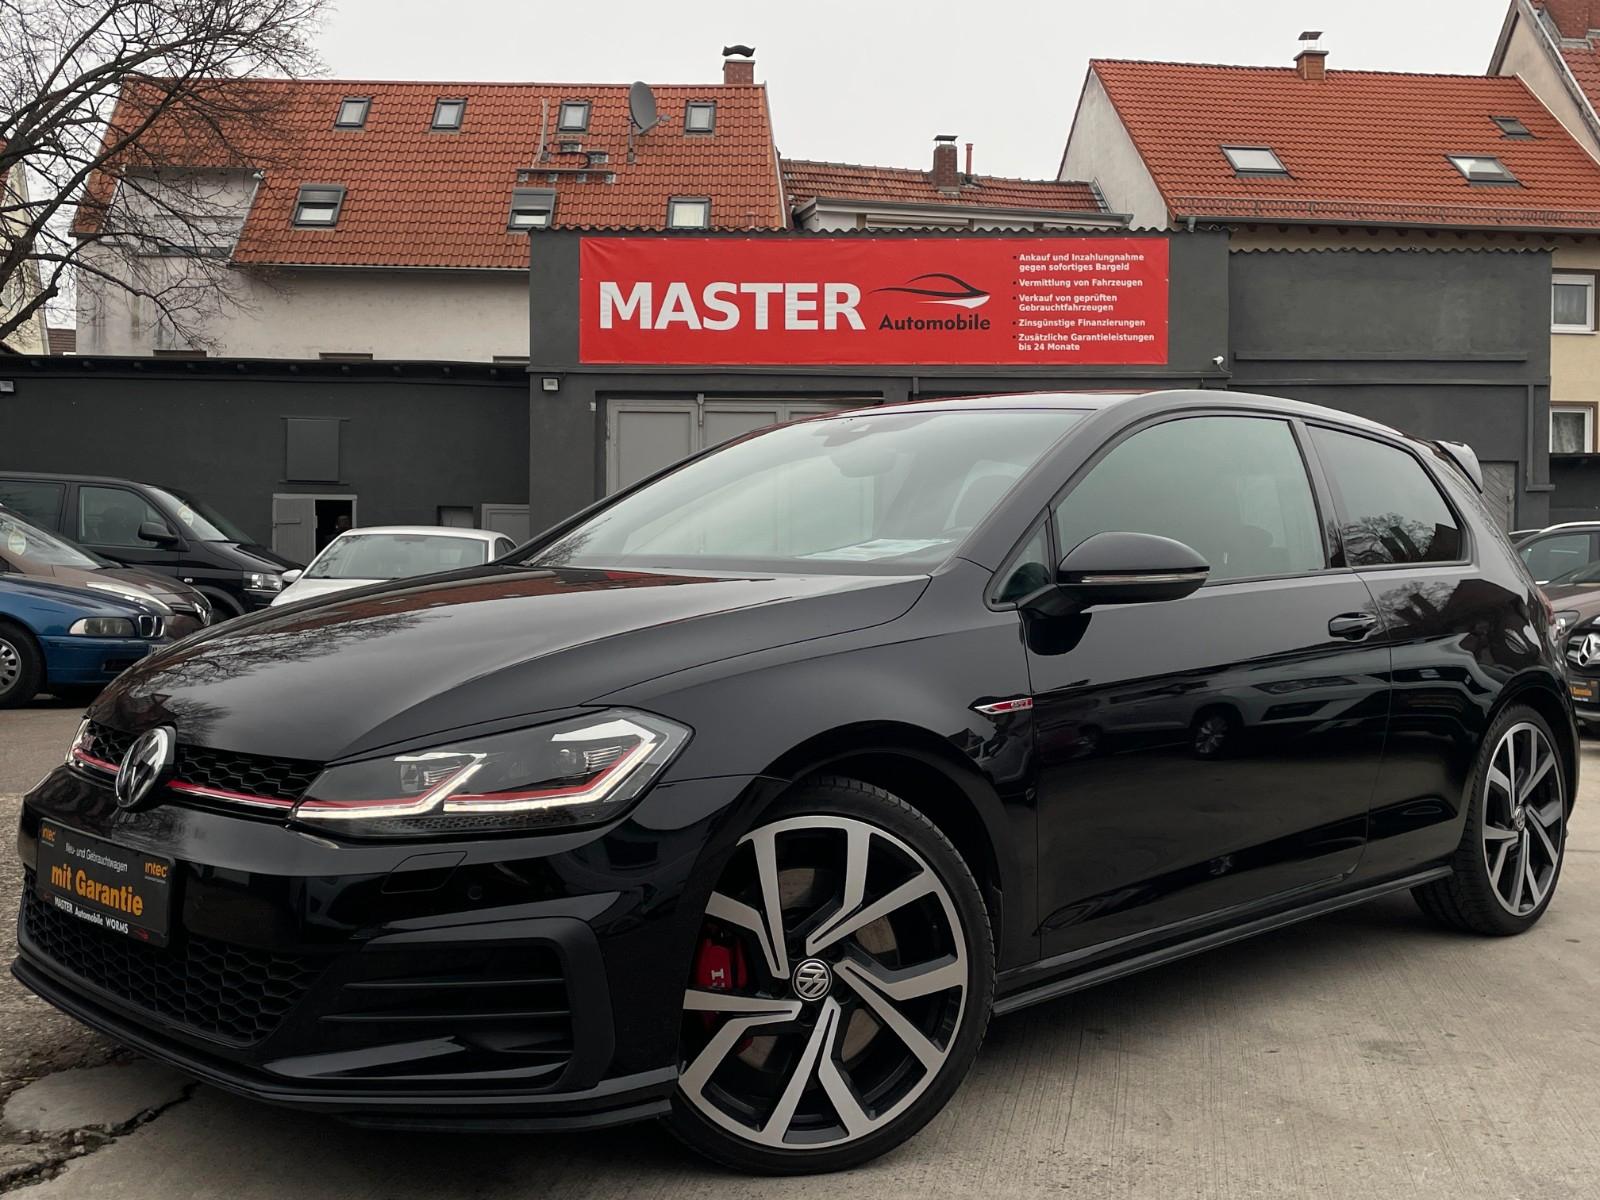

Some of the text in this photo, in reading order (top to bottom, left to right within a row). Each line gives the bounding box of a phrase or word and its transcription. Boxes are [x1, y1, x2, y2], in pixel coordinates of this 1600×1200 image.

[1072, 254, 1144, 262] Inzahlungnahme
[1019, 264, 1129, 272] gegen sofortiges Bargeld
[1019, 279, 1070, 287] Vermittlung
[1092, 279, 1143, 287] Fahrzeugen
[1019, 294, 1053, 302] Verkauf
[1074, 294, 1117, 303] geprüften
[599, 282, 866, 331] MASTER
[1019, 304, 1113, 312] Gebrauchtfahrzeugen
[879, 314, 990, 331] Automobile
[1019, 319, 1145, 328] Zinsgünstige Finanzierungen
[1071, 334, 1154, 342] Garantieleistungen
[86, 849, 127, 872] Gebrauchtwagen
[51, 864, 143, 916] mit Garantie
[54, 896, 128, 934] MASTER Automobile WORMS
